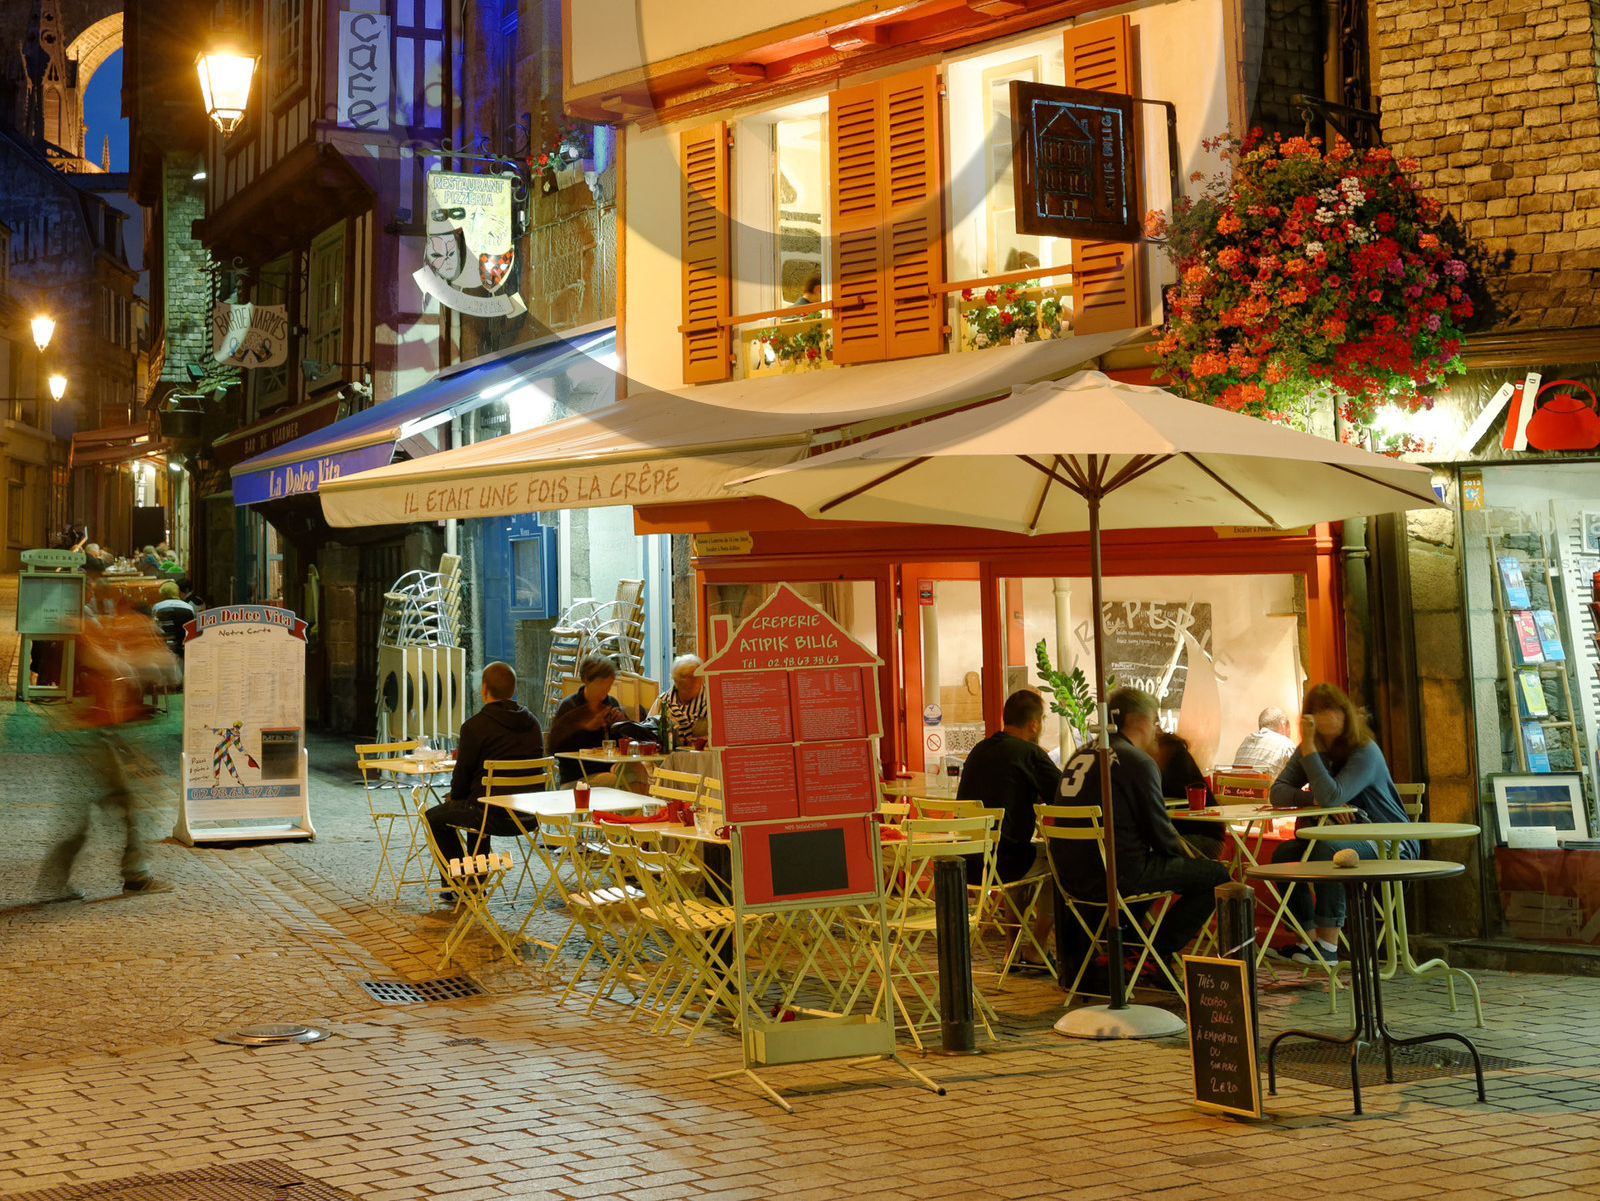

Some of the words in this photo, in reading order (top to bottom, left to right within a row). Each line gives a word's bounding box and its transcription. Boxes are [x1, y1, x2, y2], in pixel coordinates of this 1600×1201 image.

[433, 175, 504, 194] RESTAURANT
[444, 189, 494, 206] PIZZERIA
[214, 310, 239, 337] BAR
[234, 307, 248, 329] DE
[269, 470, 282, 497] La
[285, 464, 315, 495] Dolce
[318, 458, 340, 483] Vita
[404, 492, 419, 514] IL
[426, 486, 475, 512] ETAIT
[479, 482, 519, 509] UNE
[527, 476, 569, 504] FOIS
[578, 475, 601, 501] LA
[609, 463, 680, 499] CRÊPE
[200, 613, 216, 628] La
[220, 607, 260, 623] Dolce
[263, 608, 292, 626] Vita
[752, 614, 820, 630] CREPERIE
[740, 636, 789, 653] ATIPIK
[795, 633, 838, 650] BILIG
[742, 658, 757, 669] Tél
